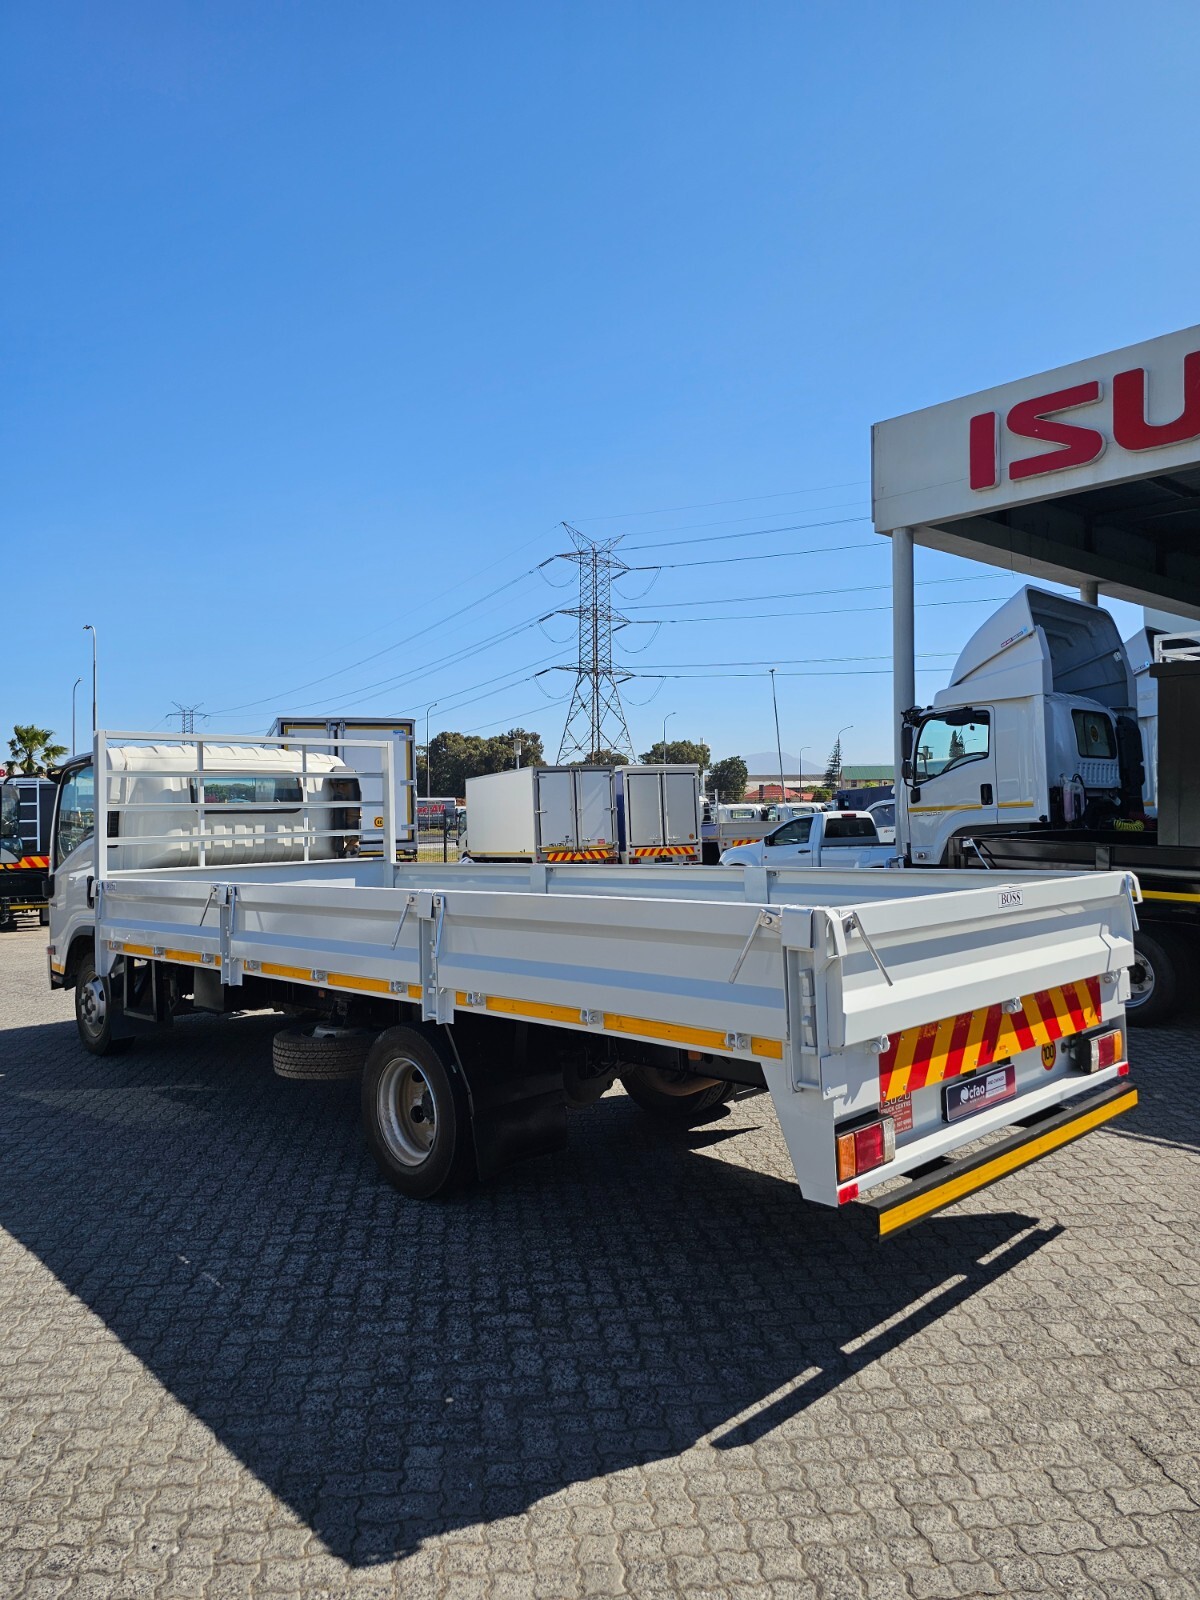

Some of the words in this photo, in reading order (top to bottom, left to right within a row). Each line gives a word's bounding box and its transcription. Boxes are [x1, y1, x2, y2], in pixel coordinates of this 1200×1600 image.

[1001, 891, 1021, 905] BOSS
[1043, 1044, 1055, 1061] 100
[969, 1084, 985, 1099] cfao
